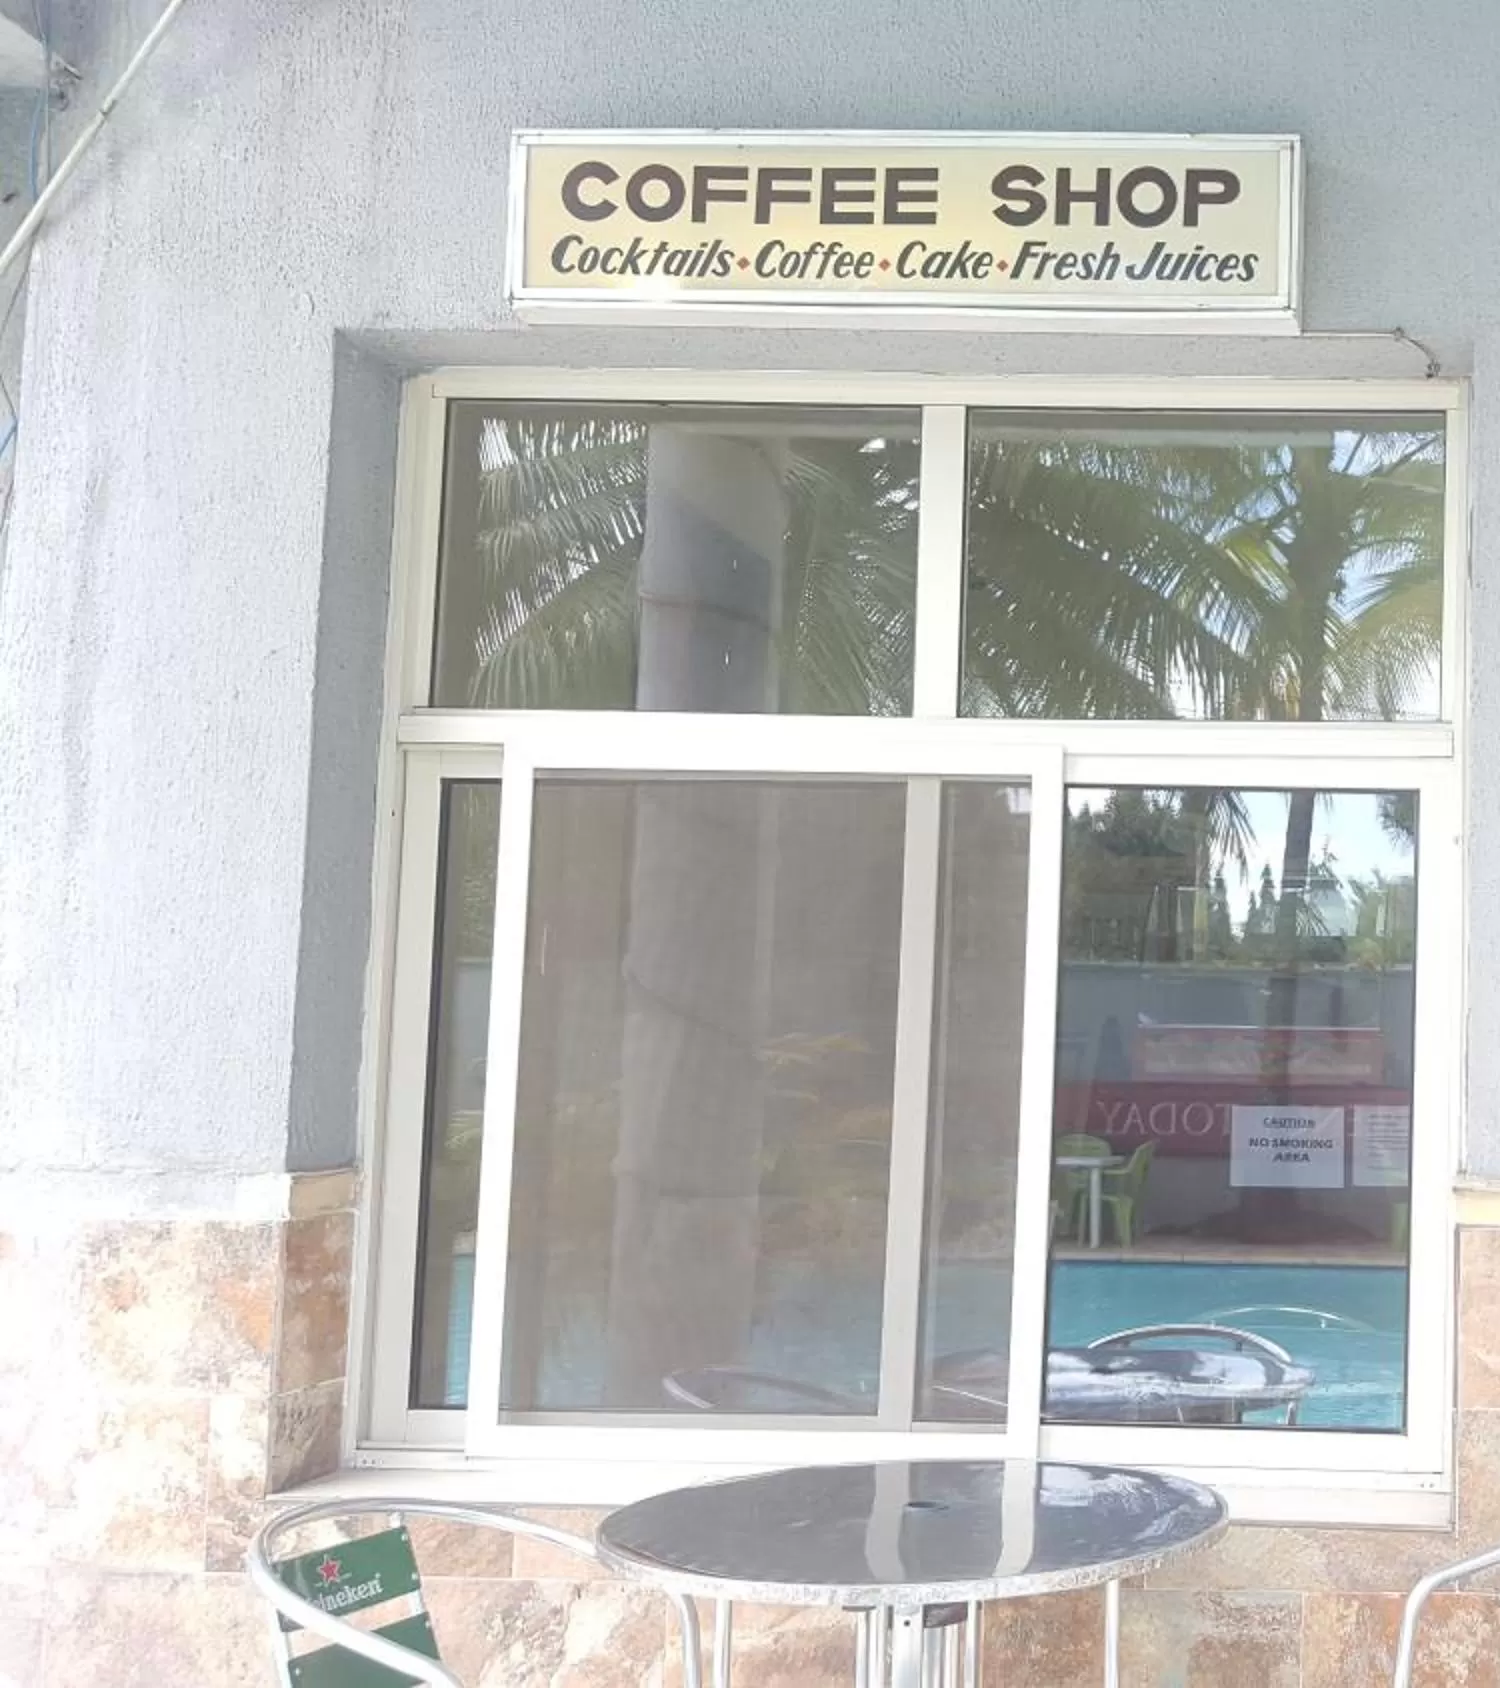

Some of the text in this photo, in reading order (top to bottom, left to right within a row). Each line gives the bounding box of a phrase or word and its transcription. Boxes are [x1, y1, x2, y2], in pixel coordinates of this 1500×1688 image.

[560, 160, 1242, 228] COFFEE SHOP
[550, 233, 1260, 282] Cocktails Coffee Cake Fresh Juices
[1262, 1116, 1317, 1129] CAUTION
[1248, 1136, 1334, 1149] NO SMOKING
[1271, 1151, 1312, 1163] AREA
